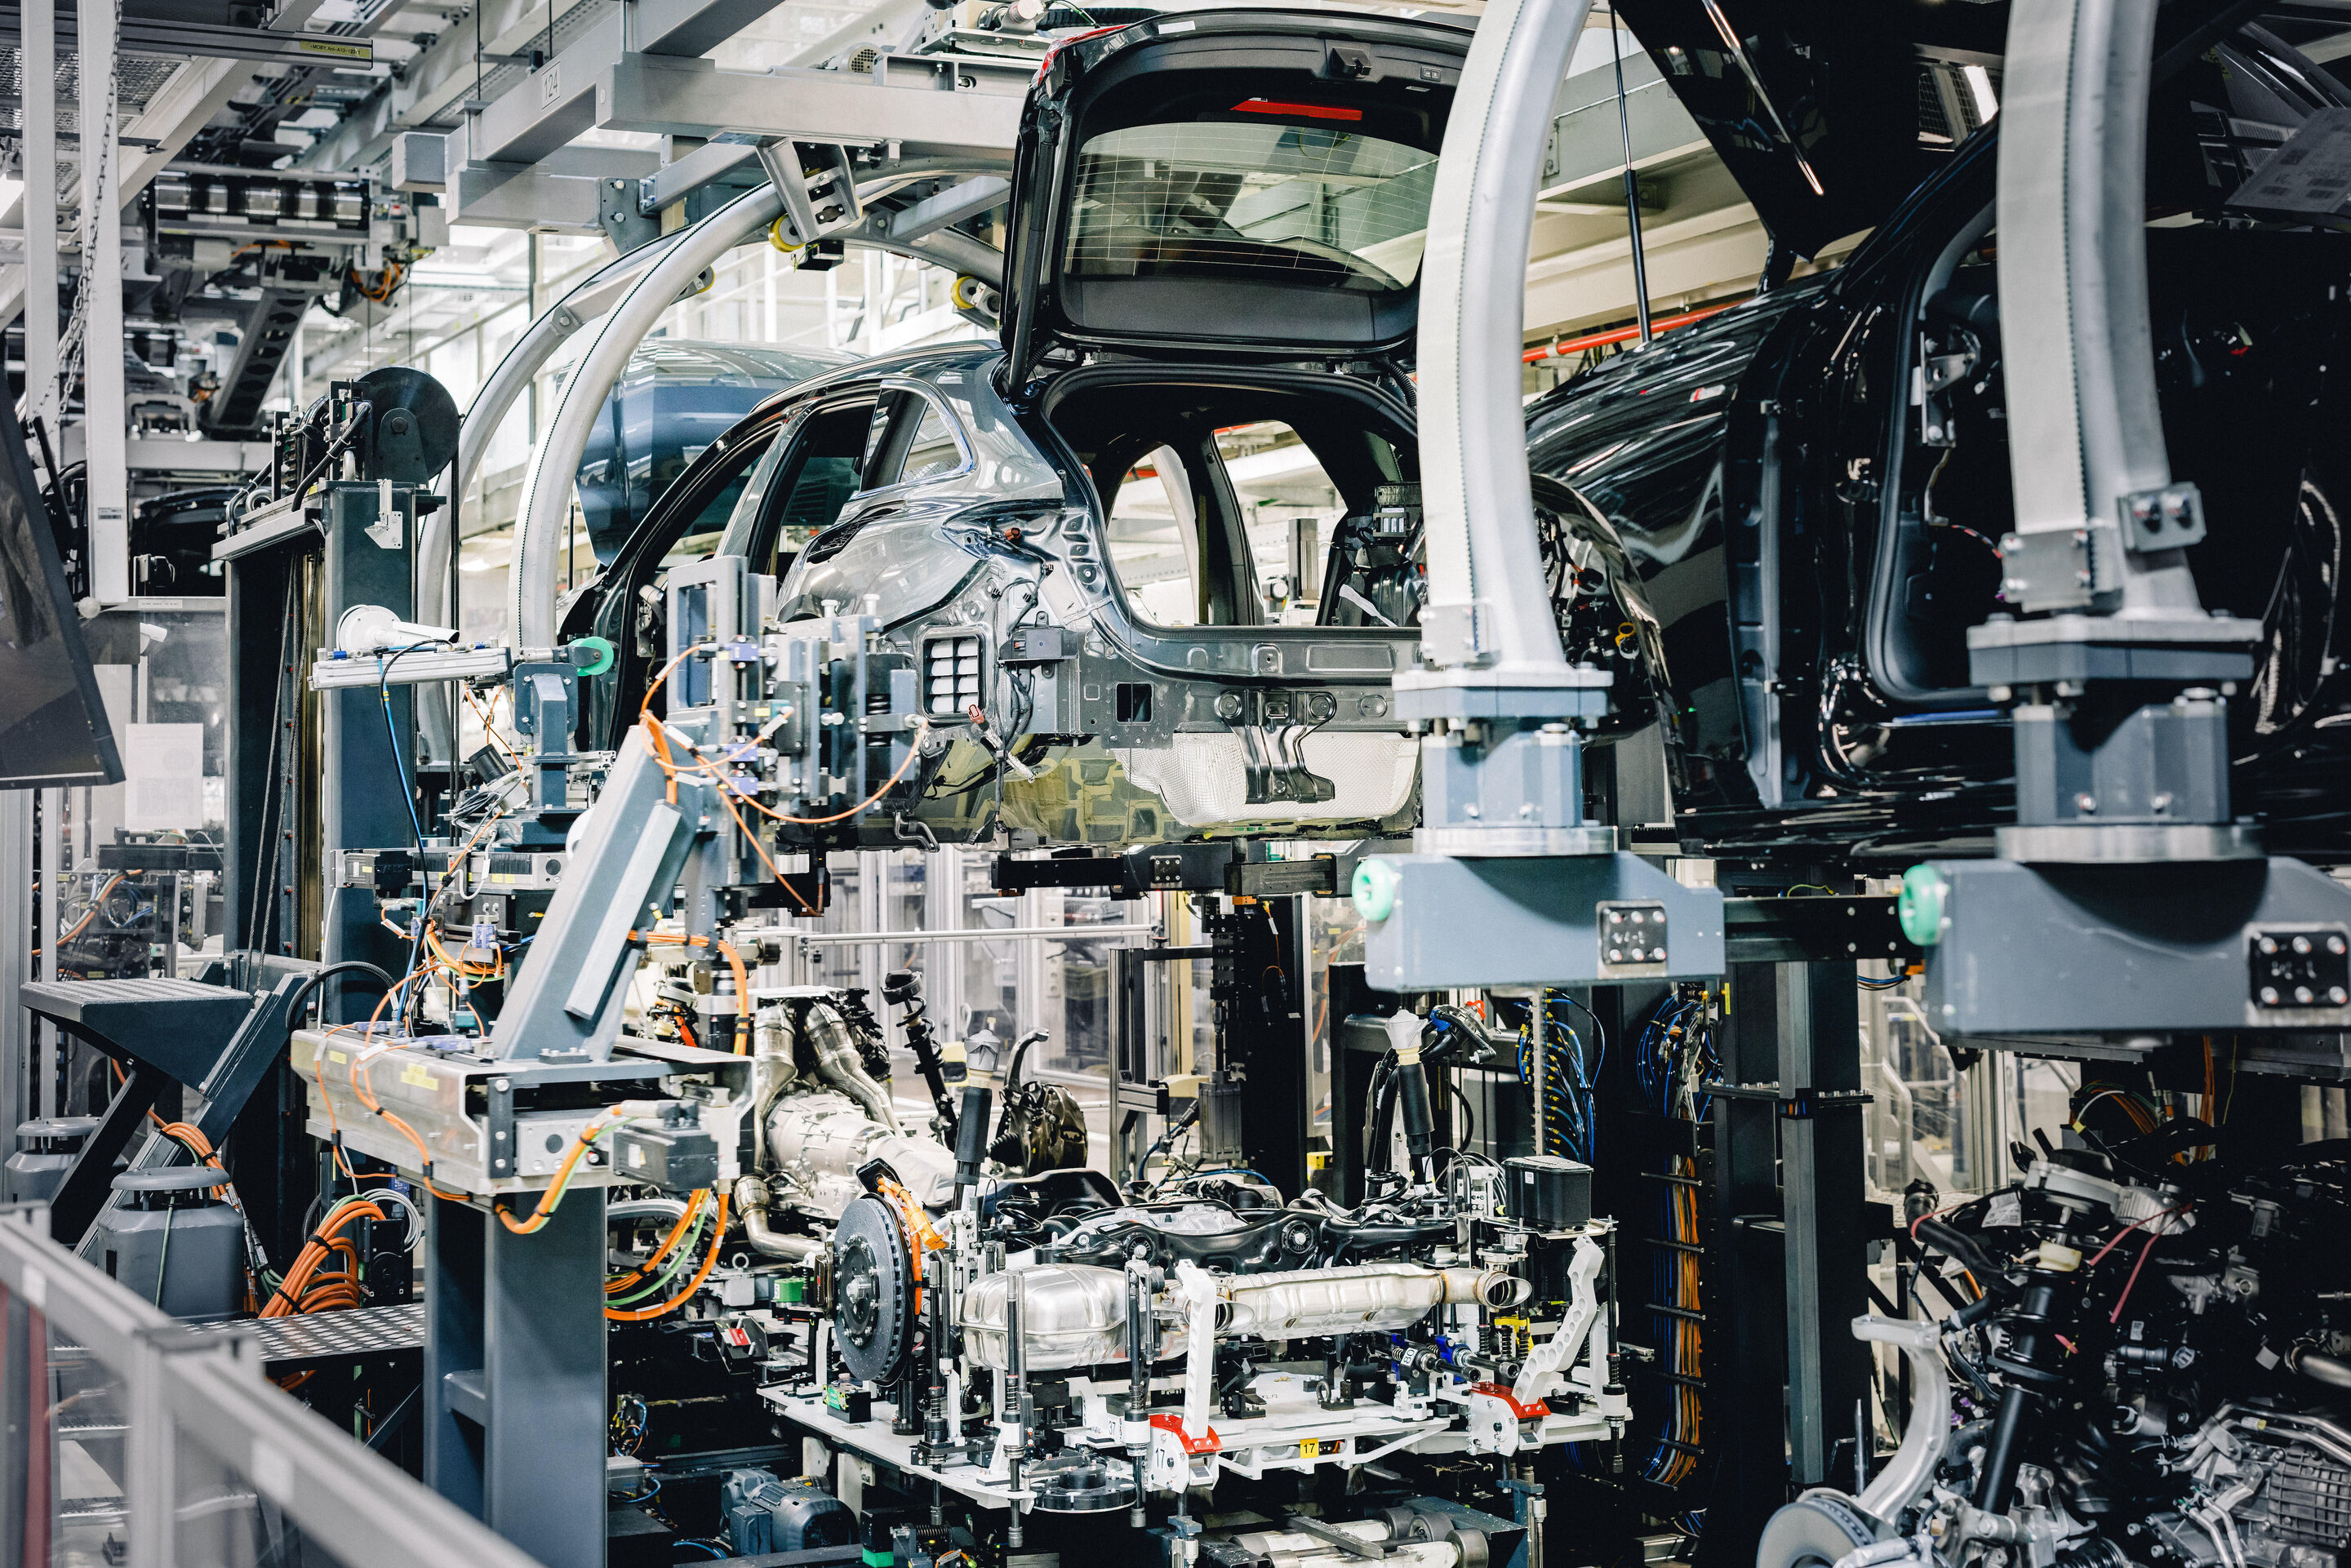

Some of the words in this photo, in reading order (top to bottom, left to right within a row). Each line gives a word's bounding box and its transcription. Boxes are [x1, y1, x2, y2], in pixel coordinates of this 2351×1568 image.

[544, 69, 558, 100] 124
[1155, 1447, 1165, 1469] 17
[1304, 1442, 1315, 1454] 17
